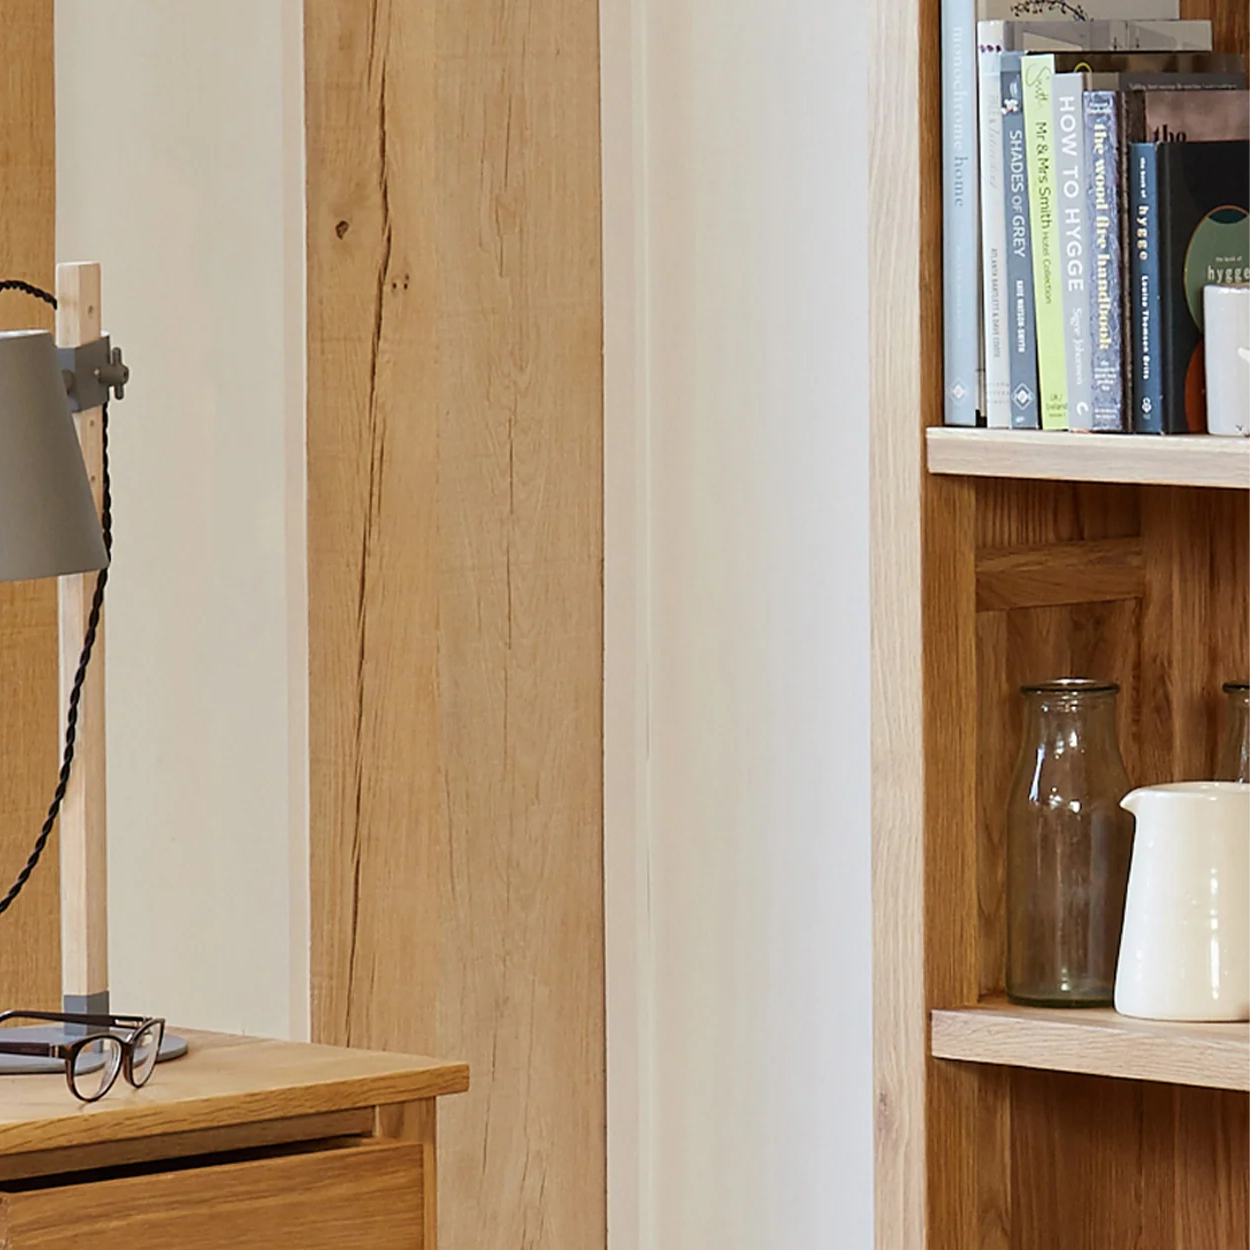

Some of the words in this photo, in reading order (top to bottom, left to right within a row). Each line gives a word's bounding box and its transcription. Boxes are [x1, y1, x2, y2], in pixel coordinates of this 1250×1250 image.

[952, 26, 966, 150] monochrome
[1036, 121, 1048, 141] Mr
[1059, 95, 1077, 156] HOW
[1093, 122, 1108, 154] the
[1009, 130, 1024, 192] SHADES
[1037, 143, 1048, 155] &
[953, 155, 969, 208] home
[1037, 157, 1050, 184] Mrs
[1062, 165, 1079, 199] TO
[1095, 159, 1109, 210] wood
[1012, 195, 1022, 213] OF
[1038, 186, 1052, 229] Smith
[1012, 215, 1026, 257] GREY
[1041, 231, 1051, 256] Hotel
[1065, 208, 1084, 292] HYGGE
[1096, 215, 1110, 250] fire
[1137, 205, 1149, 261] hygge
[1042, 258, 1054, 304] Collection
[1207, 265, 1250, 284] hygge
[1097, 253, 1112, 351] handbook
